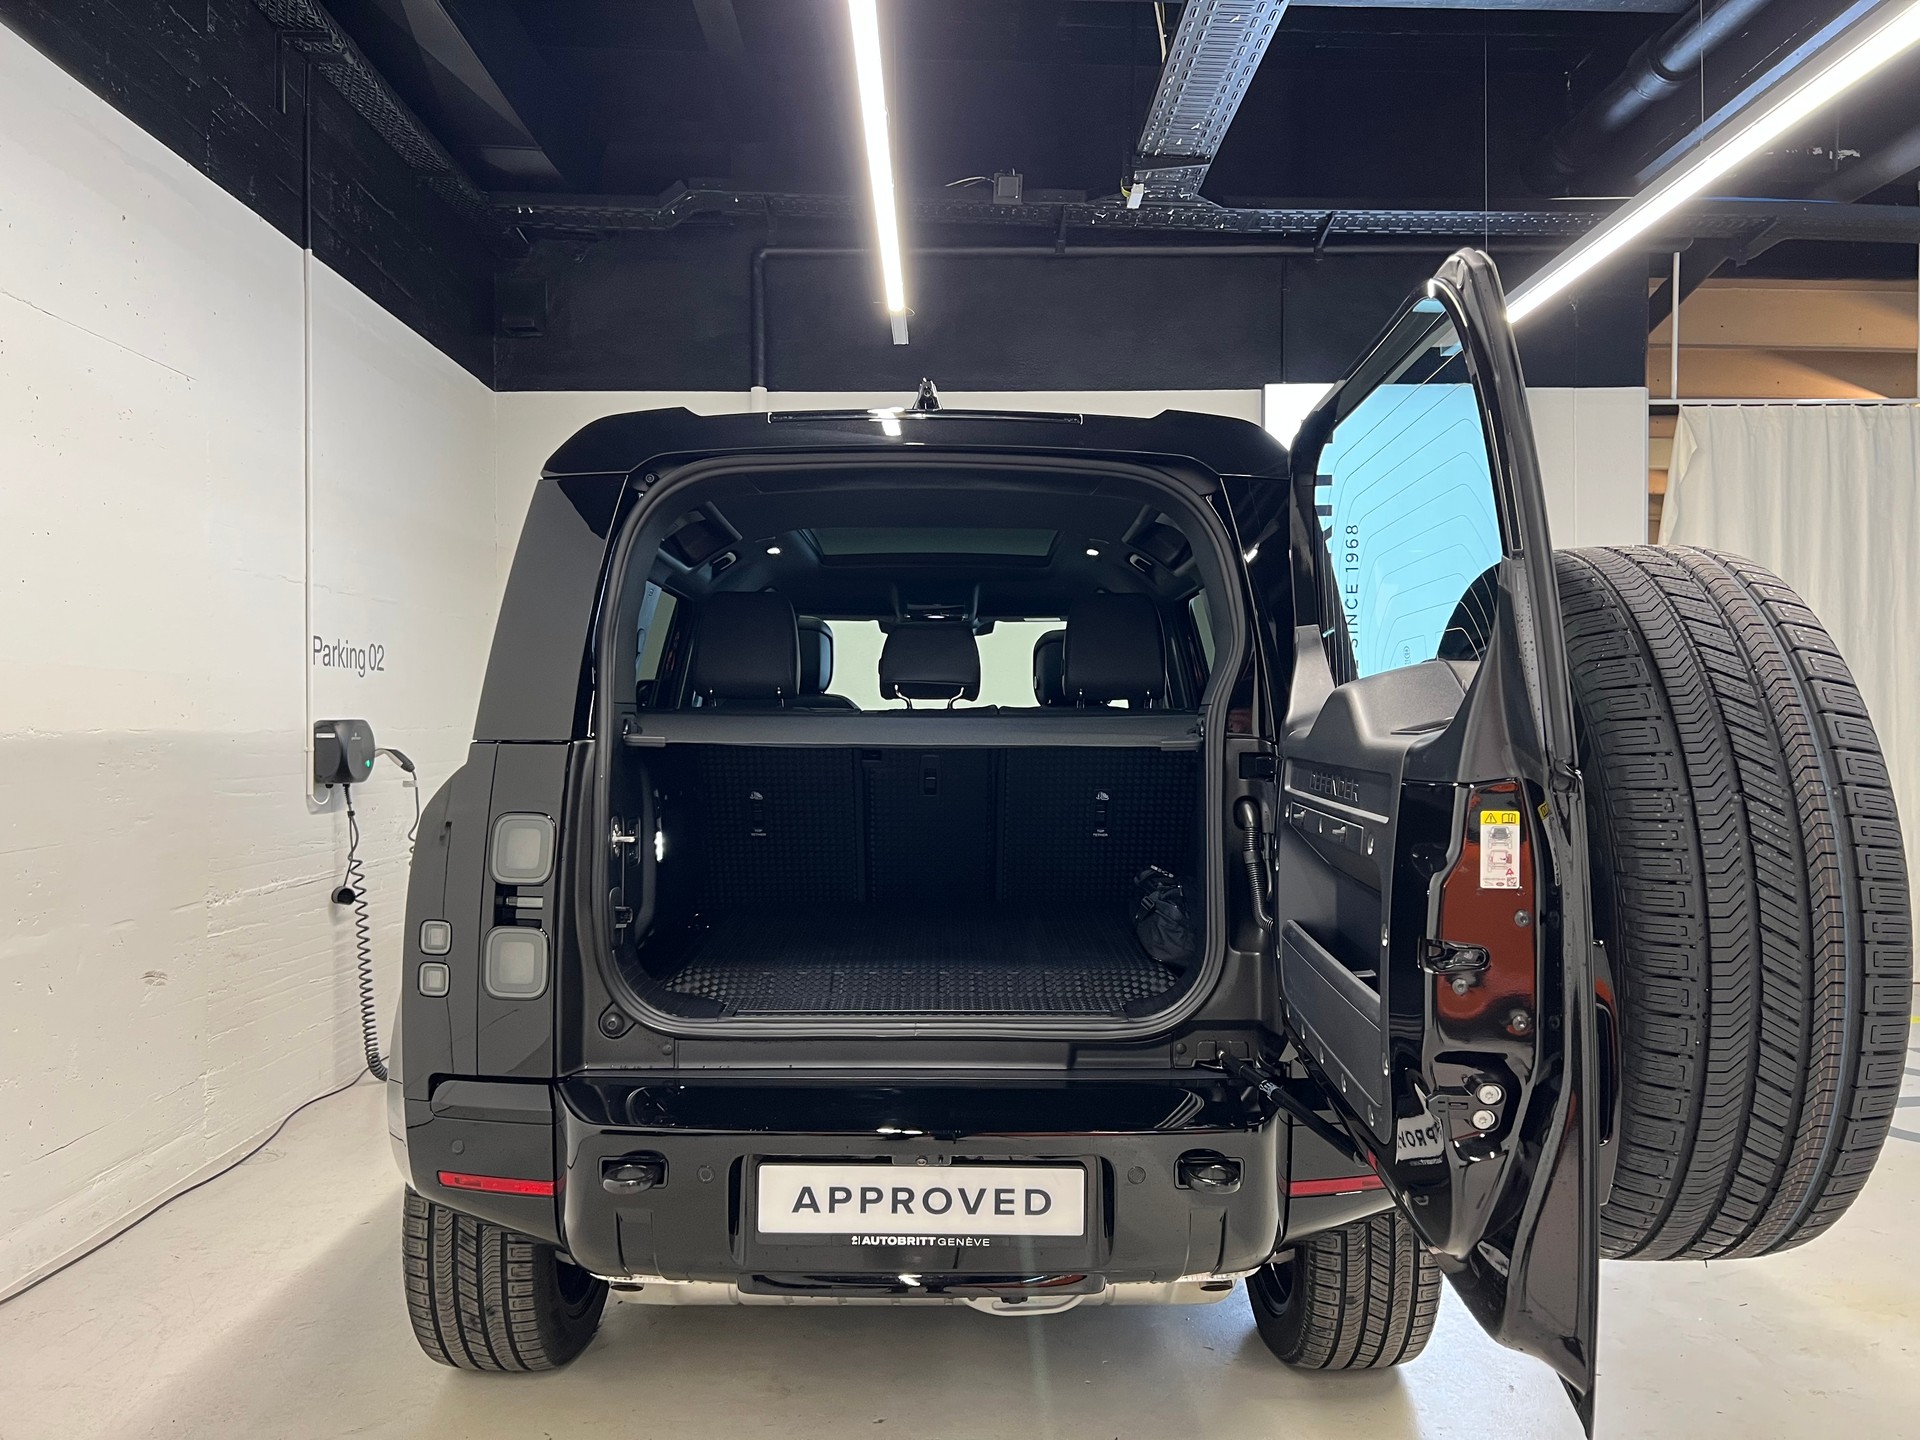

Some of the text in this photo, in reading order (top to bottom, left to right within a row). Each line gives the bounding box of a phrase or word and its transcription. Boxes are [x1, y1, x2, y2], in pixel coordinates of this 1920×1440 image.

[1345, 524, 1359, 572] 1968
[313, 635, 385, 678] Parking 02
[791, 1186, 1052, 1216] APPROVED
[861, 1235, 991, 1247] AUTOBRITT GENÈVE
